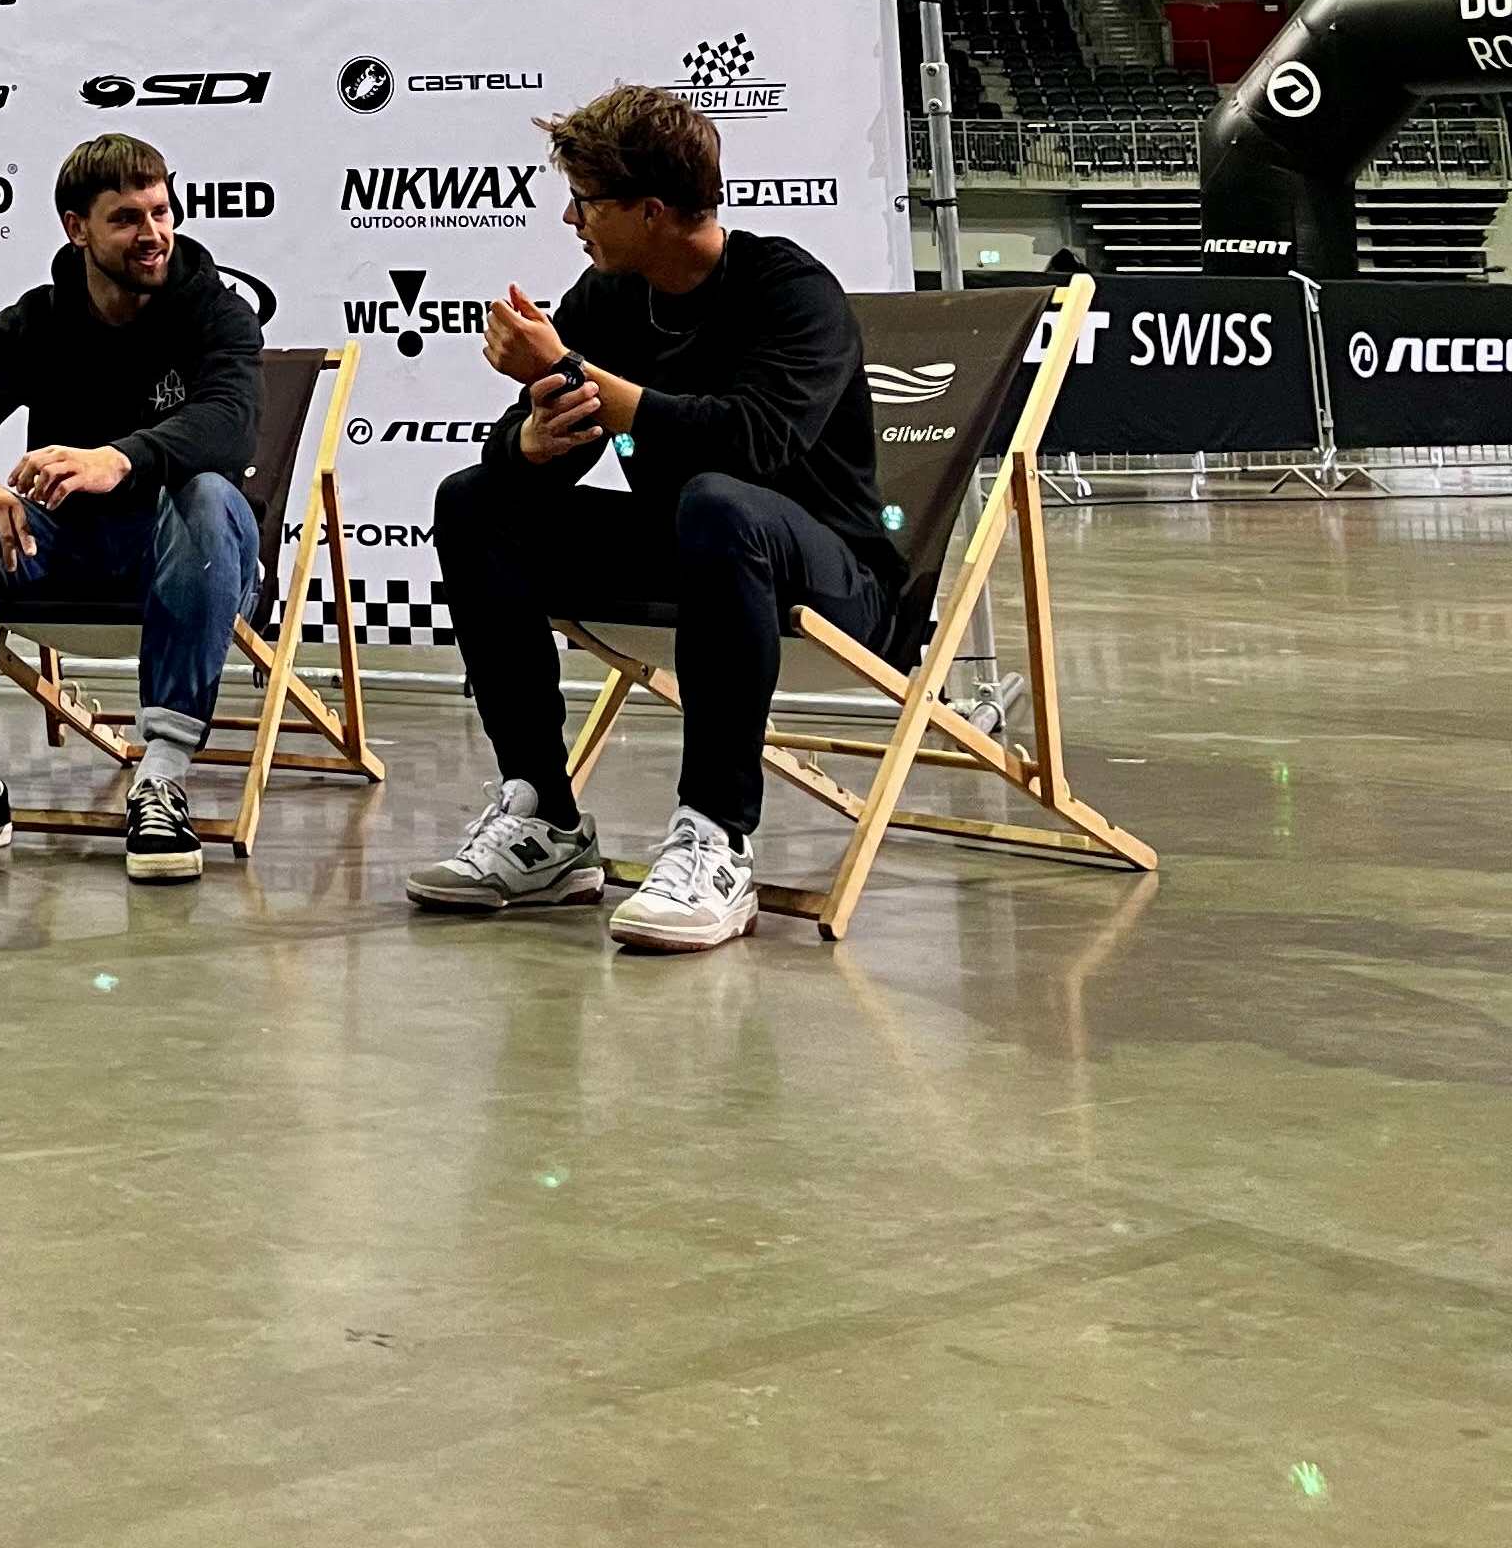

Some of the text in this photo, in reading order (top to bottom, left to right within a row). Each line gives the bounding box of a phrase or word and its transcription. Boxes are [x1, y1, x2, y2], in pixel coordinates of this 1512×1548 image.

[675, 90, 785, 108] NISH LINE
[341, 166, 536, 211] NIKWAX
[720, 180, 837, 206] PARK
[351, 215, 525, 228] OUTDOOR INNOVATION
[1131, 312, 1271, 365] SWISS
[883, 425, 955, 441] Gliwice
